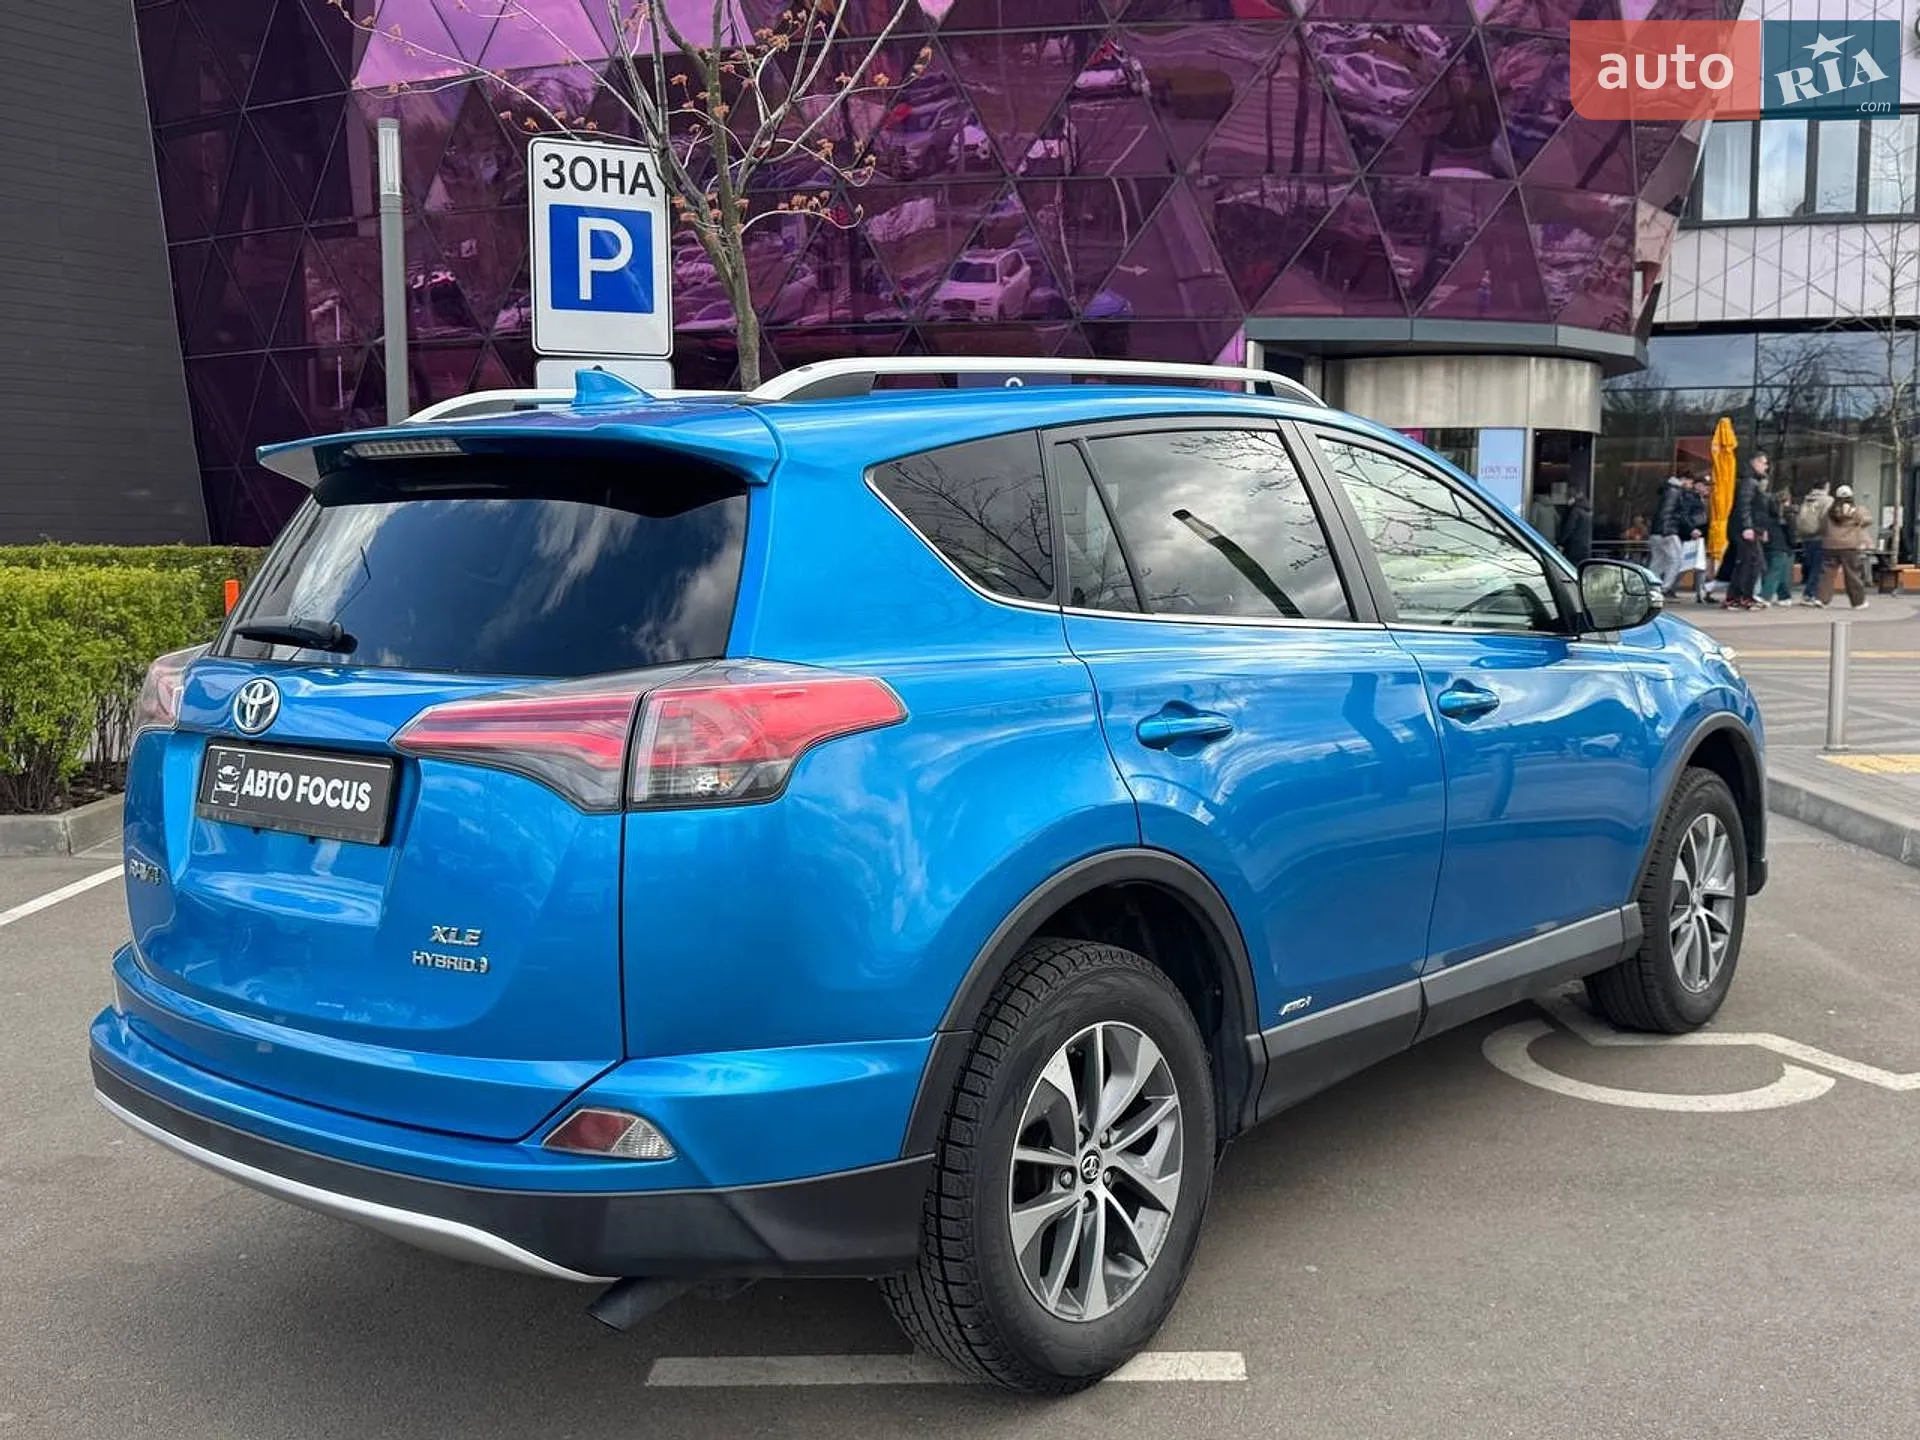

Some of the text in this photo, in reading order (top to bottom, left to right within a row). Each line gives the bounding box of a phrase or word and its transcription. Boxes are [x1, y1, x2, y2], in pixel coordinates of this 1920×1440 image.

[542, 153, 657, 197] ЗОНА
[577, 216, 633, 300] P
[241, 768, 372, 813] АВТО FOCUS
[429, 925, 482, 946] XLE
[411, 950, 476, 972] HYBRID
